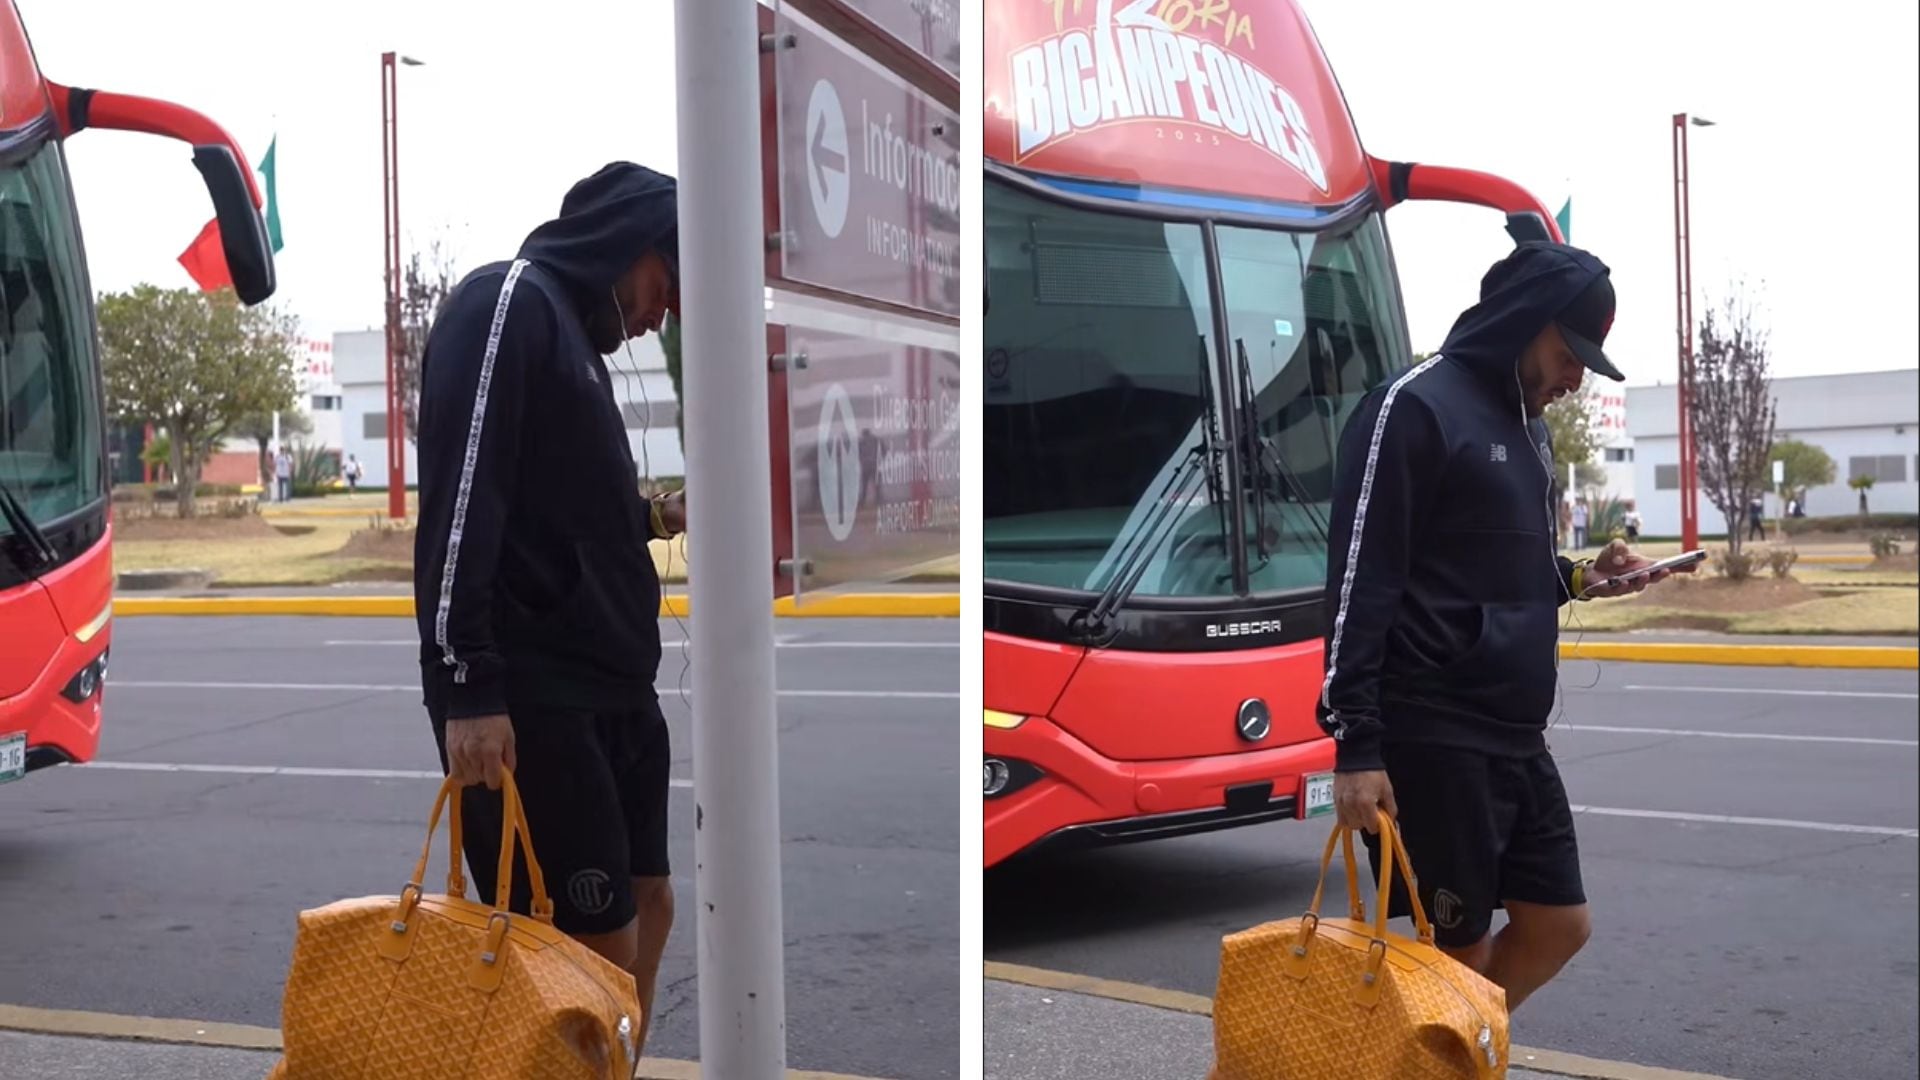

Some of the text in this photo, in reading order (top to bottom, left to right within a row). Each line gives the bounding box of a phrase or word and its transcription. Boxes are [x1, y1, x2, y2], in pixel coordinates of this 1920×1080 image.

[1012, 27, 1328, 192] BICAMPEONES
[861, 99, 960, 213] Informac
[1155, 127, 1221, 146] 2025
[866, 213, 953, 279] INFORMATION
[876, 500, 921, 534] AIRPORT
[1206, 619, 1281, 637] BUSSCAR
